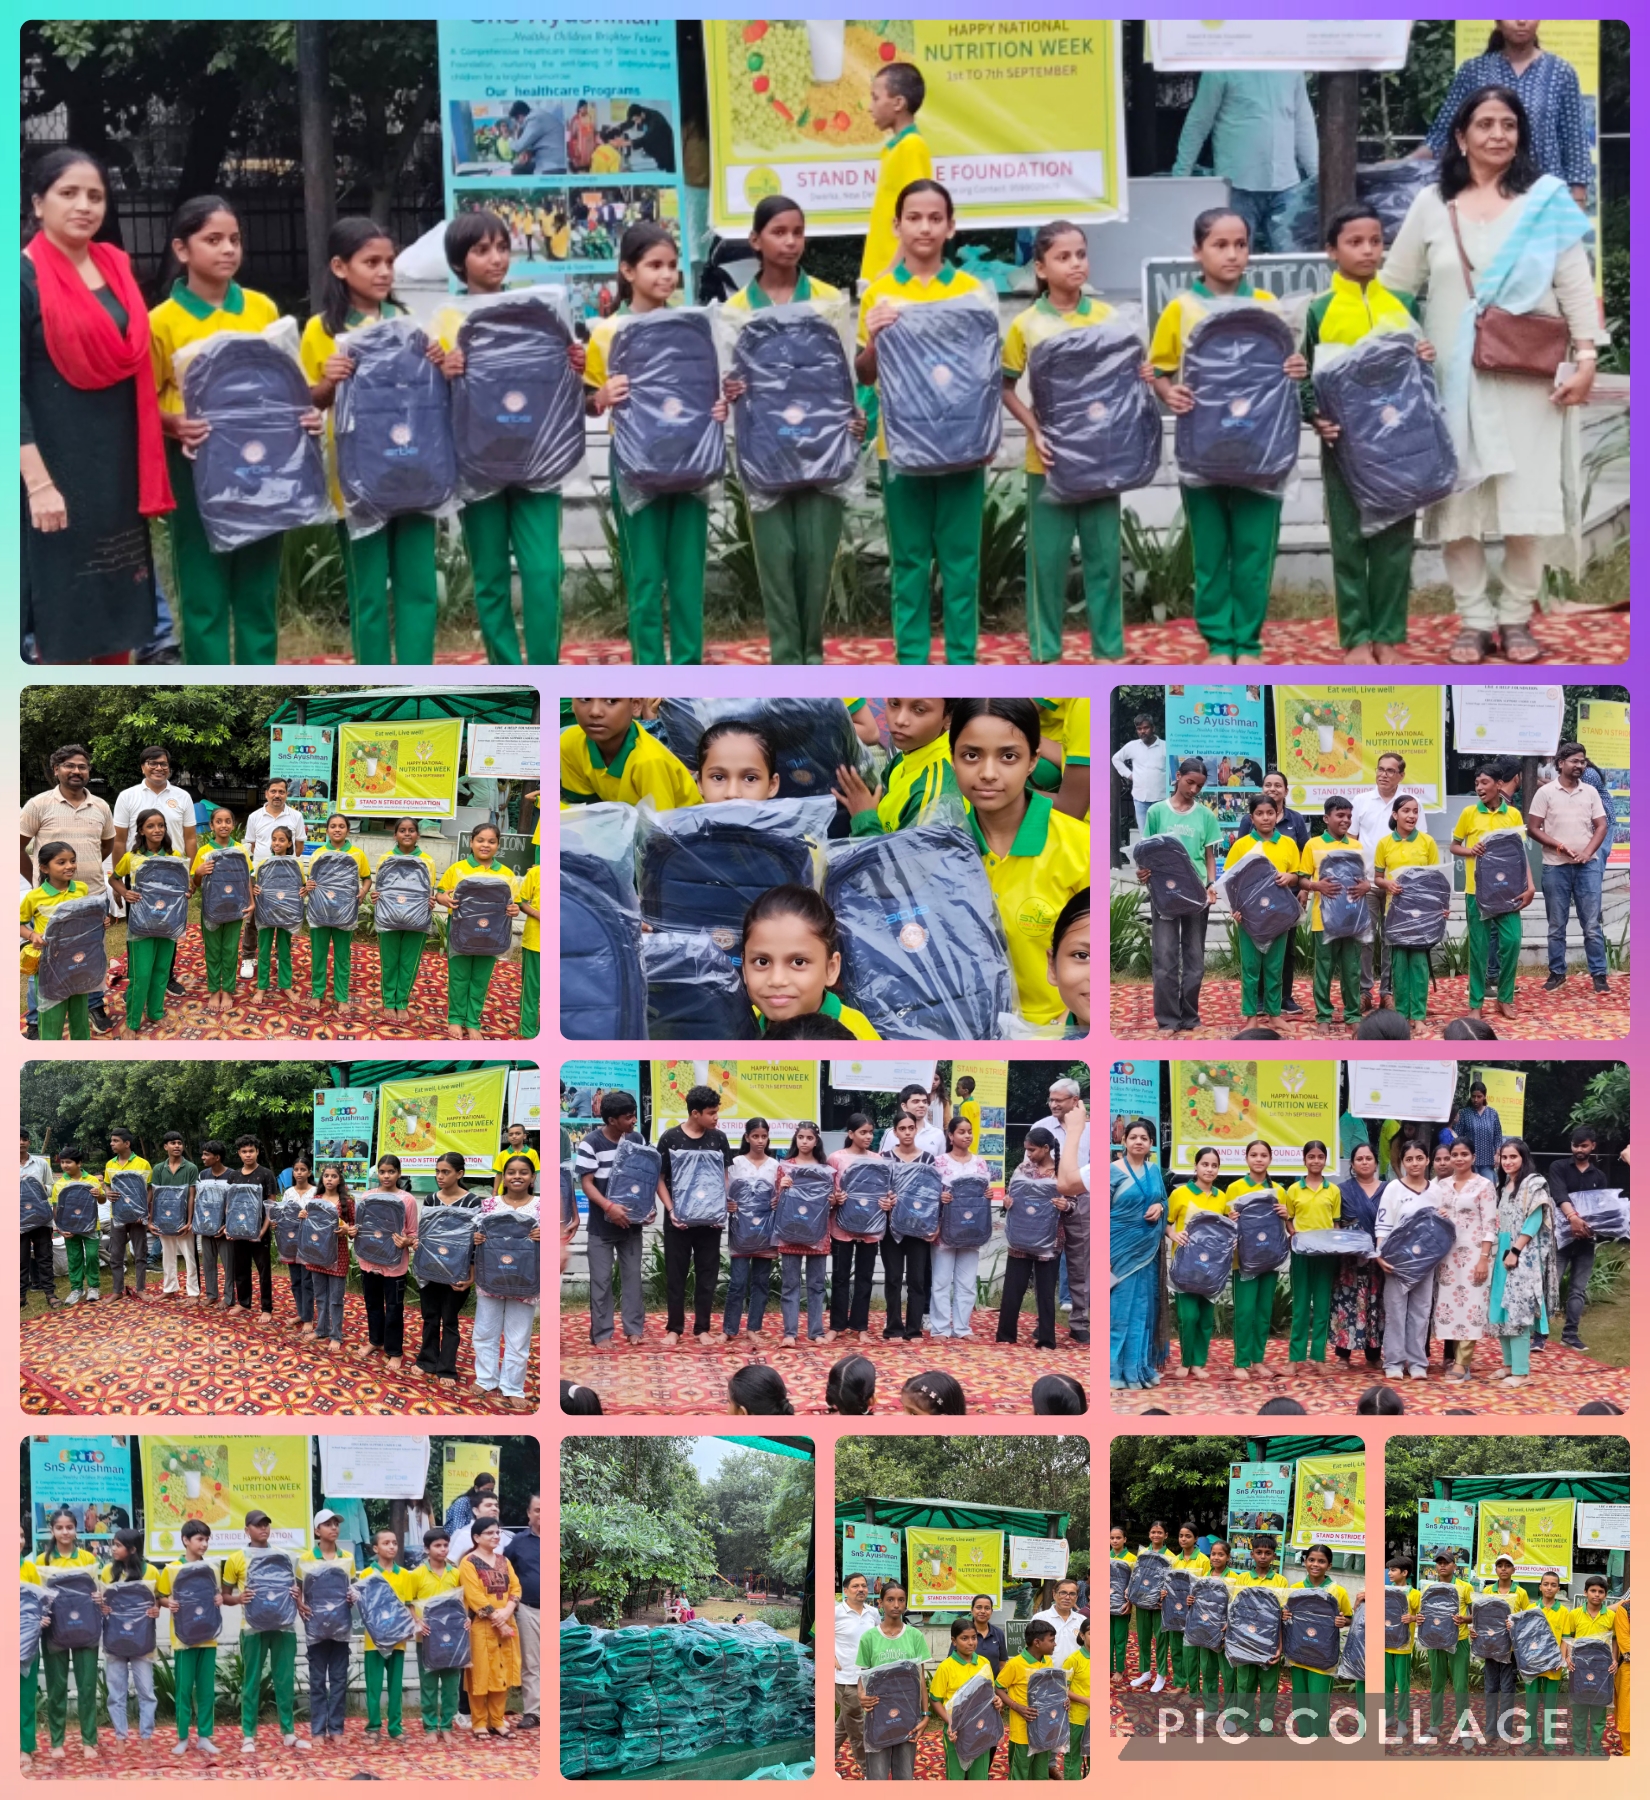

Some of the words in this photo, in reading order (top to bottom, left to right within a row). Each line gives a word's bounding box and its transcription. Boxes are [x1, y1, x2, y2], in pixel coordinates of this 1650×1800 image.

[948, 22, 996, 37] HAPPY
[998, 20, 1069, 35] NATIONAL
[924, 41, 1035, 61] NUTRITION
[1039, 38, 1094, 57] WEEK
[966, 67, 982, 80] TO
[1006, 64, 1077, 79] SEPTEMBER
[485, 86, 507, 98] Our
[514, 85, 580, 97] healthcare
[583, 86, 641, 99] Programs
[797, 170, 858, 188] STAND
[863, 169, 876, 184] N
[951, 161, 1073, 181] FOUNDATION
[1340, 686, 1358, 694] well,
[1179, 715, 1200, 725] SnS
[1204, 716, 1258, 727] Ayushman
[1582, 727, 1602, 735] STAND
[957, 1065, 978, 1074] STAND
[986, 1068, 1006, 1076] STRIDE
[741, 1073, 785, 1082] NUTRITION
[787, 1073, 809, 1081] WEEK
[44, 1463, 65, 1472] SnS
[69, 1464, 124, 1474] Ayushman
[448, 1469, 468, 1478] STAND
[866, 1551, 898, 1560] Ayushman
